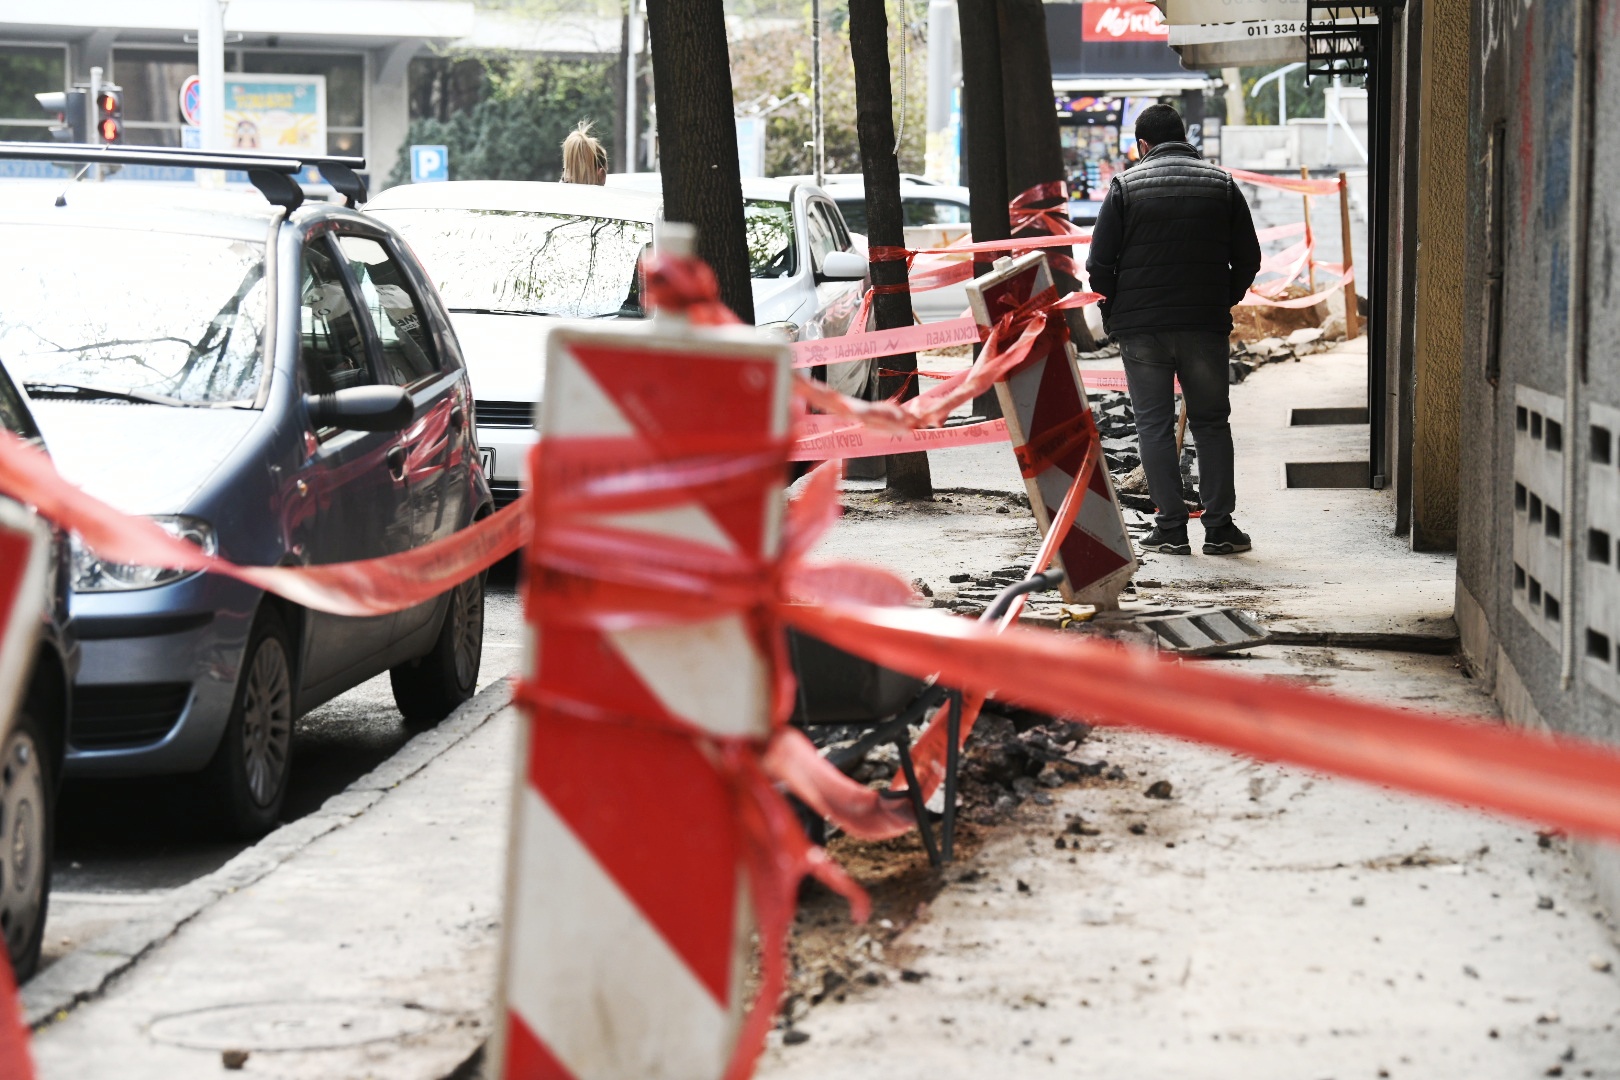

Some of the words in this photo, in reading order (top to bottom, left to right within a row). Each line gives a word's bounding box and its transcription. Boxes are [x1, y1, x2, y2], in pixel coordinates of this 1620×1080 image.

[1247, 26, 1269, 37] 011
[1274, 23, 1296, 35] 334
[418, 150, 441, 179] P
